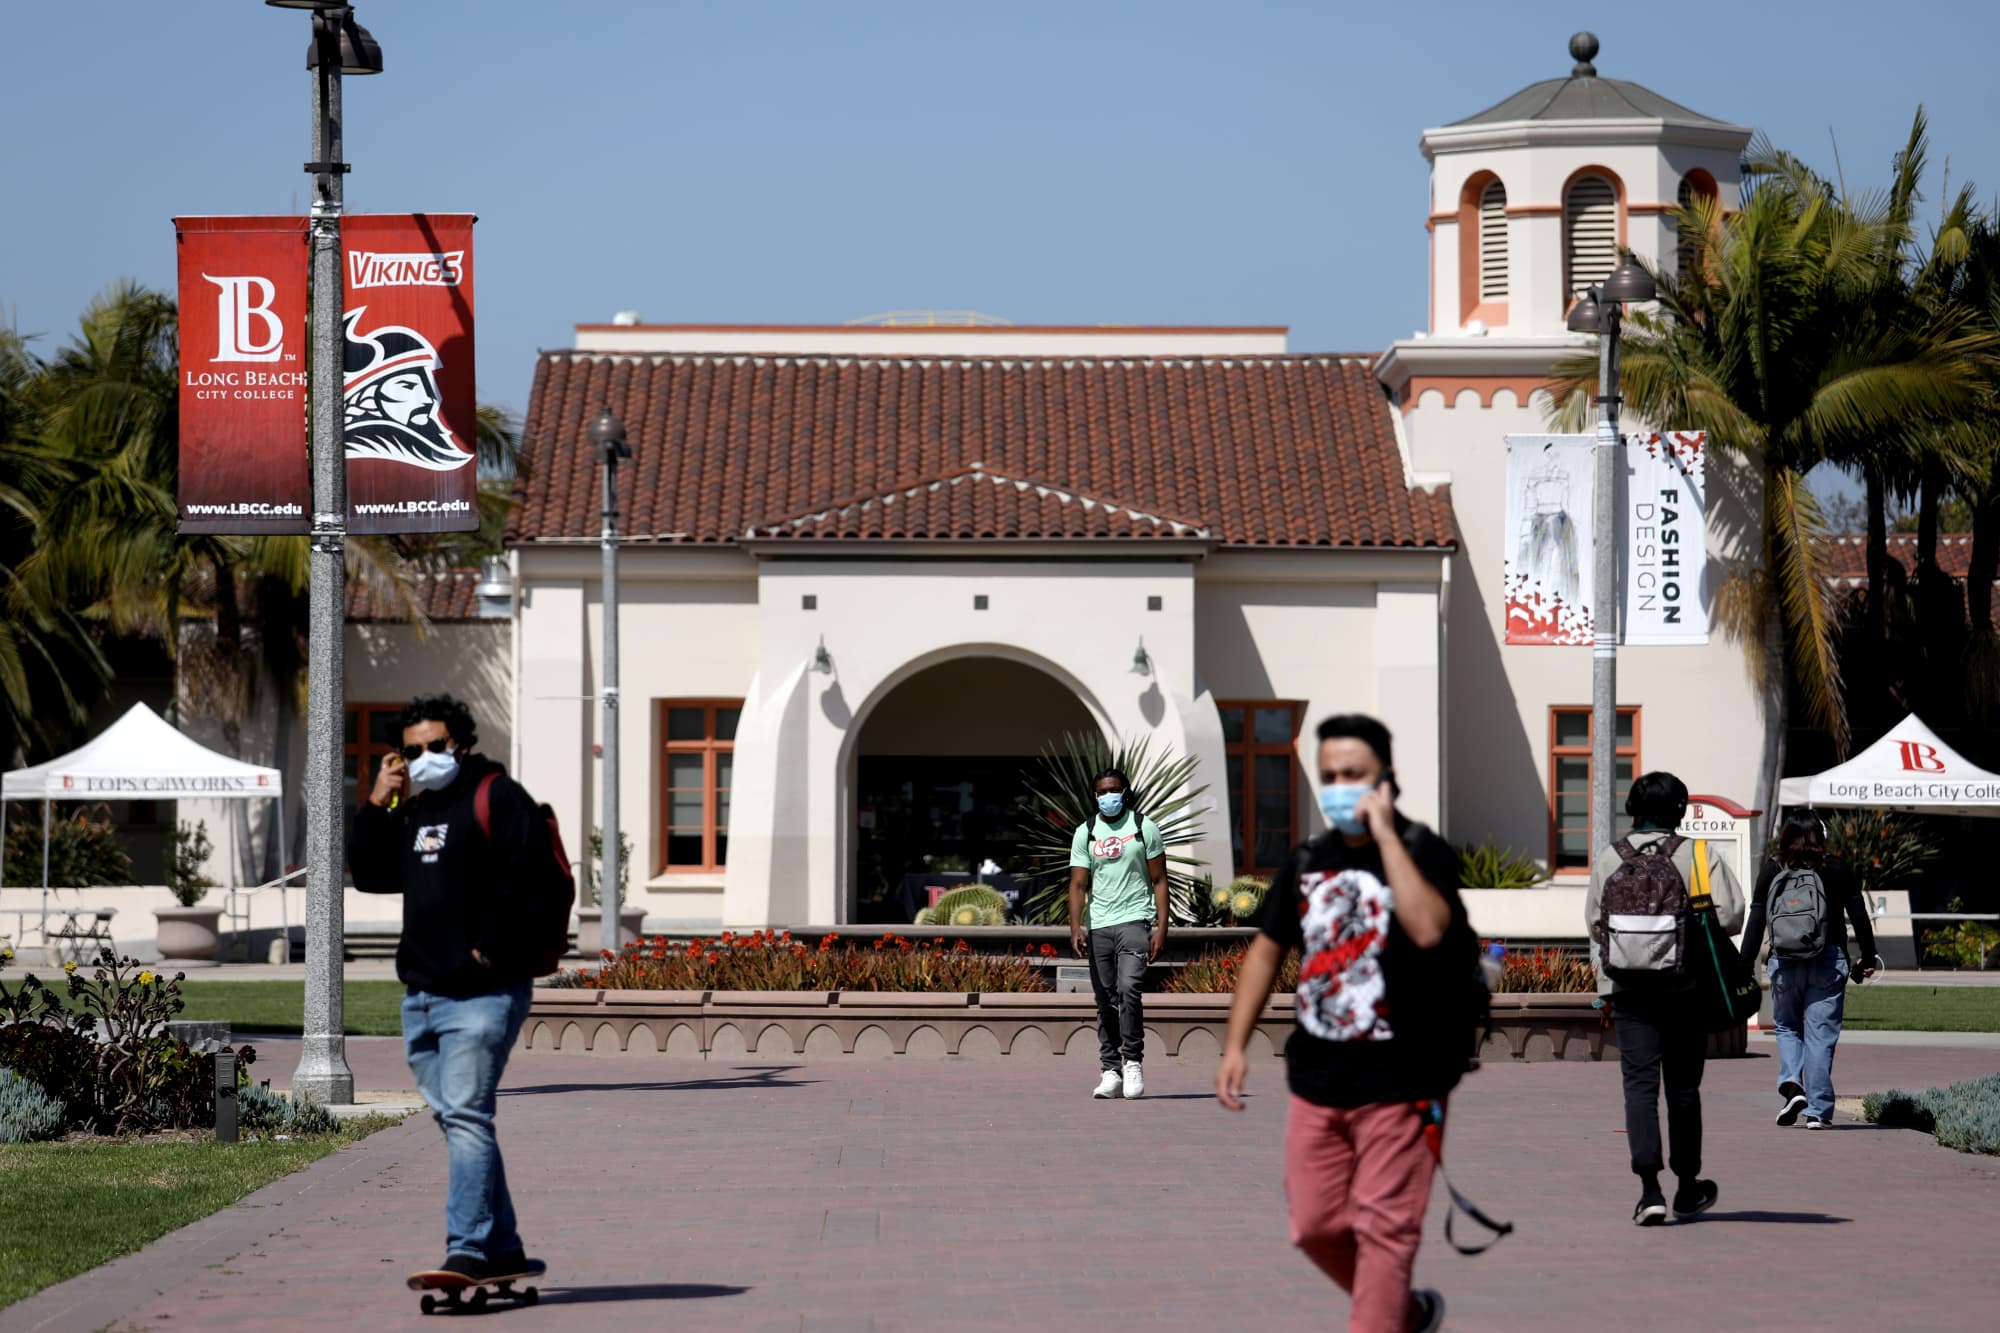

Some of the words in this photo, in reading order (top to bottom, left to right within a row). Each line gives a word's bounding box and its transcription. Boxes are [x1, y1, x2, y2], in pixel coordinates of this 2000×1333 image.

[349, 251, 464, 289] VIKINGS
[186, 371, 239, 386] LONG
[245, 370, 304, 386] BEACH
[196, 390, 228, 400] CITY
[234, 390, 294, 400] COLLEGE
[186, 503, 303, 515] www.LBCC.edu
[354, 499, 470, 514] www.LBCC.edu
[1636, 503, 1656, 611] DESIGN
[1660, 489, 1681, 624] FASHION
[1829, 782, 1868, 800] Long
[1874, 783, 1923, 798] Beach
[1928, 783, 1960, 801] City
